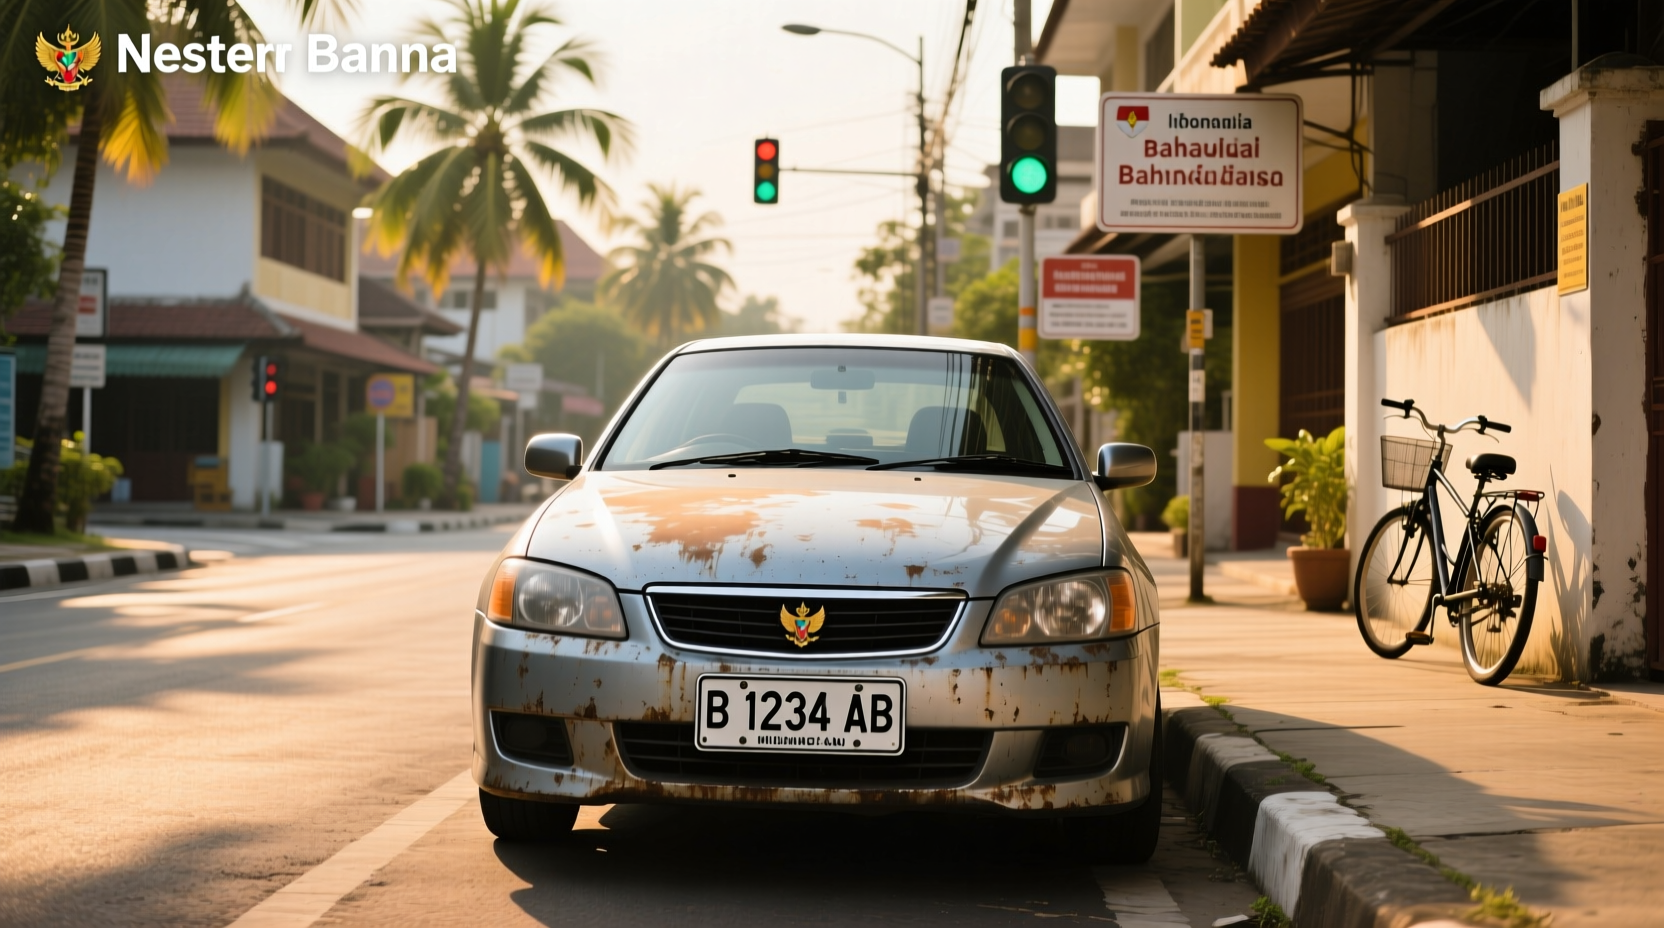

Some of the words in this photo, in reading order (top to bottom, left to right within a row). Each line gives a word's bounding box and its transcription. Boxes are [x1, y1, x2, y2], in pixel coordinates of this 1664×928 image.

[706, 690, 729, 729] B
[745, 690, 831, 732] 1234
[843, 694, 893, 733] AB
